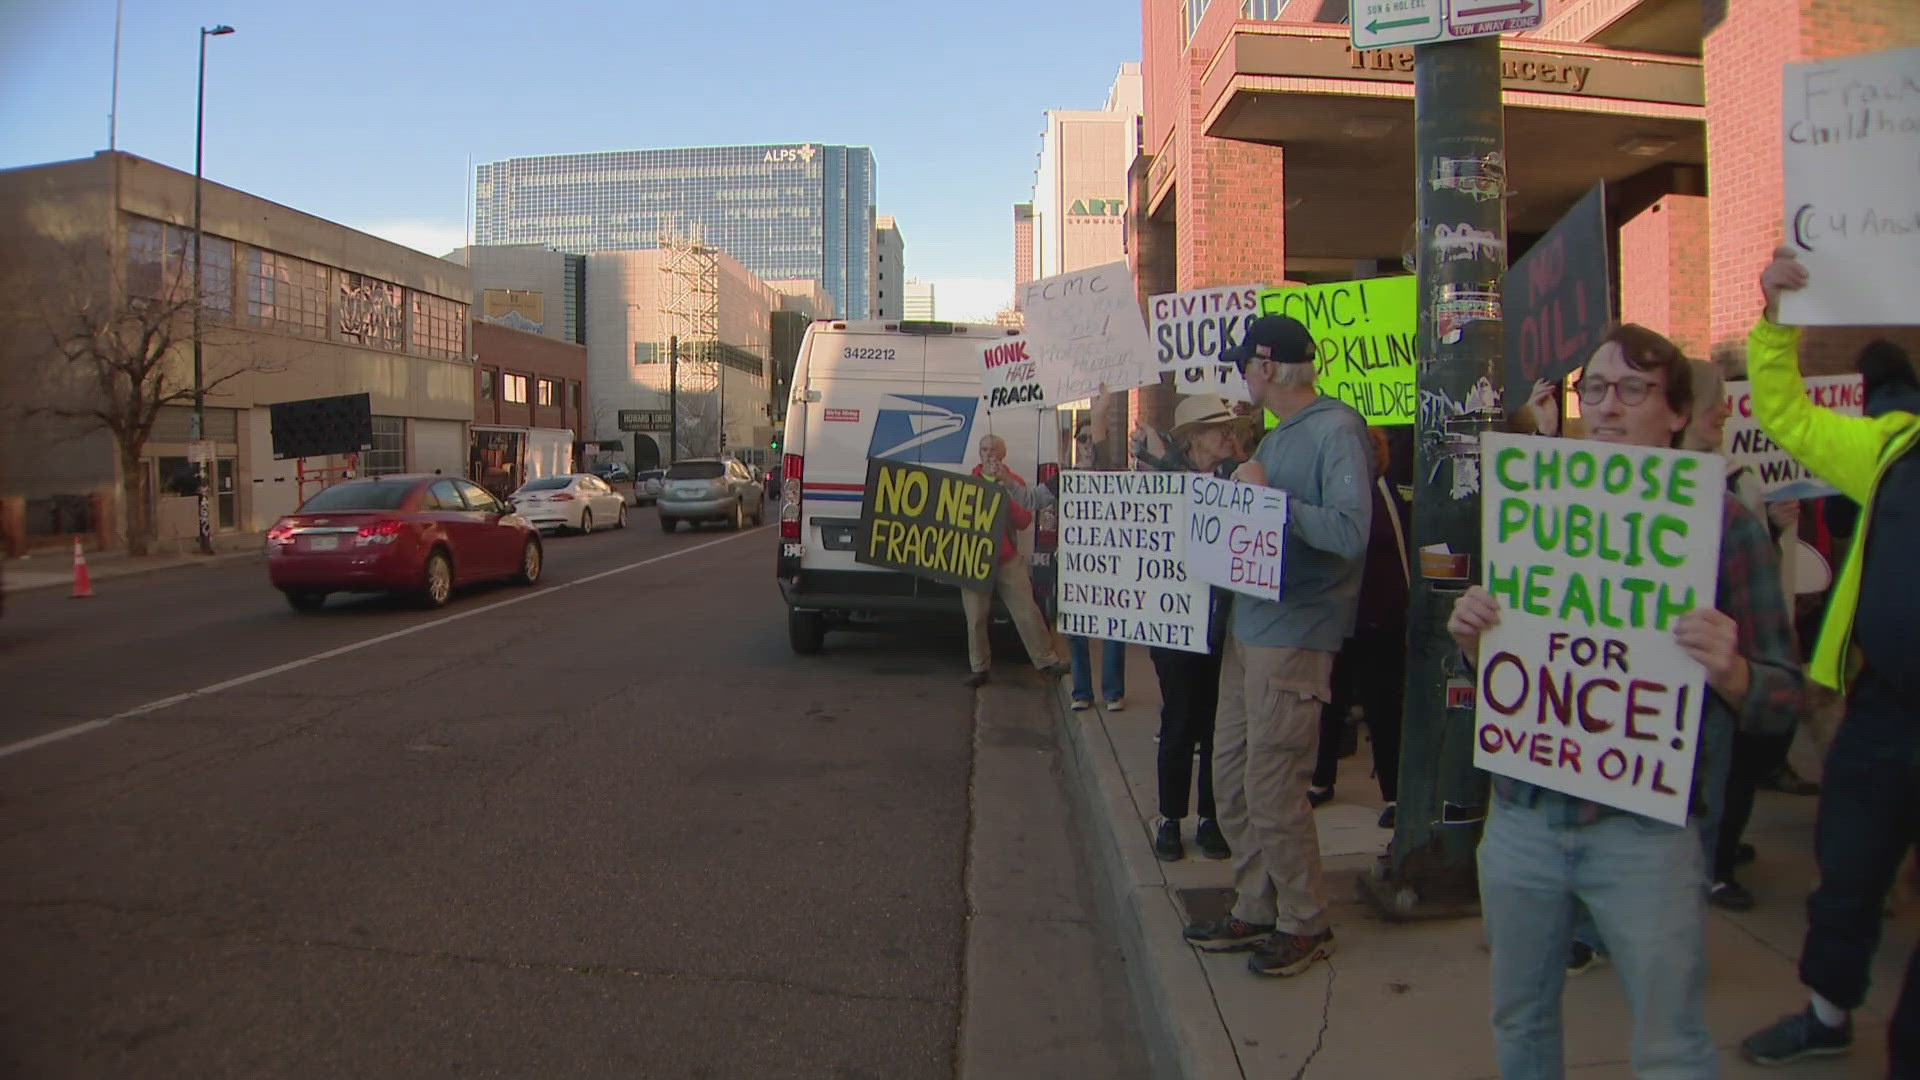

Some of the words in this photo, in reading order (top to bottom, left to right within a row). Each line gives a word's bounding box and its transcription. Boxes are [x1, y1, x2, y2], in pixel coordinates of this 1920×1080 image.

[1367, 5, 1383, 15] SUN
[1394, 1, 1408, 11] HOL
[1455, 25, 1475, 35] TOW
[1478, 20, 1506, 33] AWAY
[1510, 17, 1537, 28] ZONE
[1345, 45, 1414, 72] The
[1502, 62, 1591, 92] ncery
[764, 149, 797, 161] ALPS
[1067, 198, 1124, 216] ART
[1529, 234, 1565, 309] NO
[1155, 289, 1257, 320] CIVITAS
[1520, 280, 1589, 381] OIL!
[844, 347, 896, 360] 3422212
[984, 340, 1030, 370] HONK
[1006, 361, 1036, 383] HATE
[1338, 381, 1416, 418] CHILDRE
[623, 413, 650, 423] HOWARD
[1496, 446, 1699, 508] CHOOSE
[874, 466, 929, 518] NO
[935, 478, 1001, 533] NEW
[1063, 500, 1173, 524] CHEAPEST
[1192, 477, 1255, 514] SOLAR
[870, 518, 994, 580] FRACKING
[1064, 526, 1175, 552] CLEANEST
[1191, 512, 1221, 544] NO
[1229, 525, 1278, 557] GAS
[1498, 497, 1689, 568] PUBLIC
[1066, 552, 1121, 576] MOST
[1135, 557, 1187, 582] JOBS
[1230, 556, 1279, 590] BILL
[1063, 582, 1147, 610] ENERGY
[1160, 593, 1192, 614] ON
[1488, 561, 1696, 631] HEALTH
[1059, 612, 1099, 634] THE
[1107, 617, 1194, 646] PLANET
[1549, 633, 1629, 674] FOR
[1483, 651, 1688, 751] ONCE!
[1479, 723, 1582, 774] OVER
[1598, 748, 1678, 796] OIL
